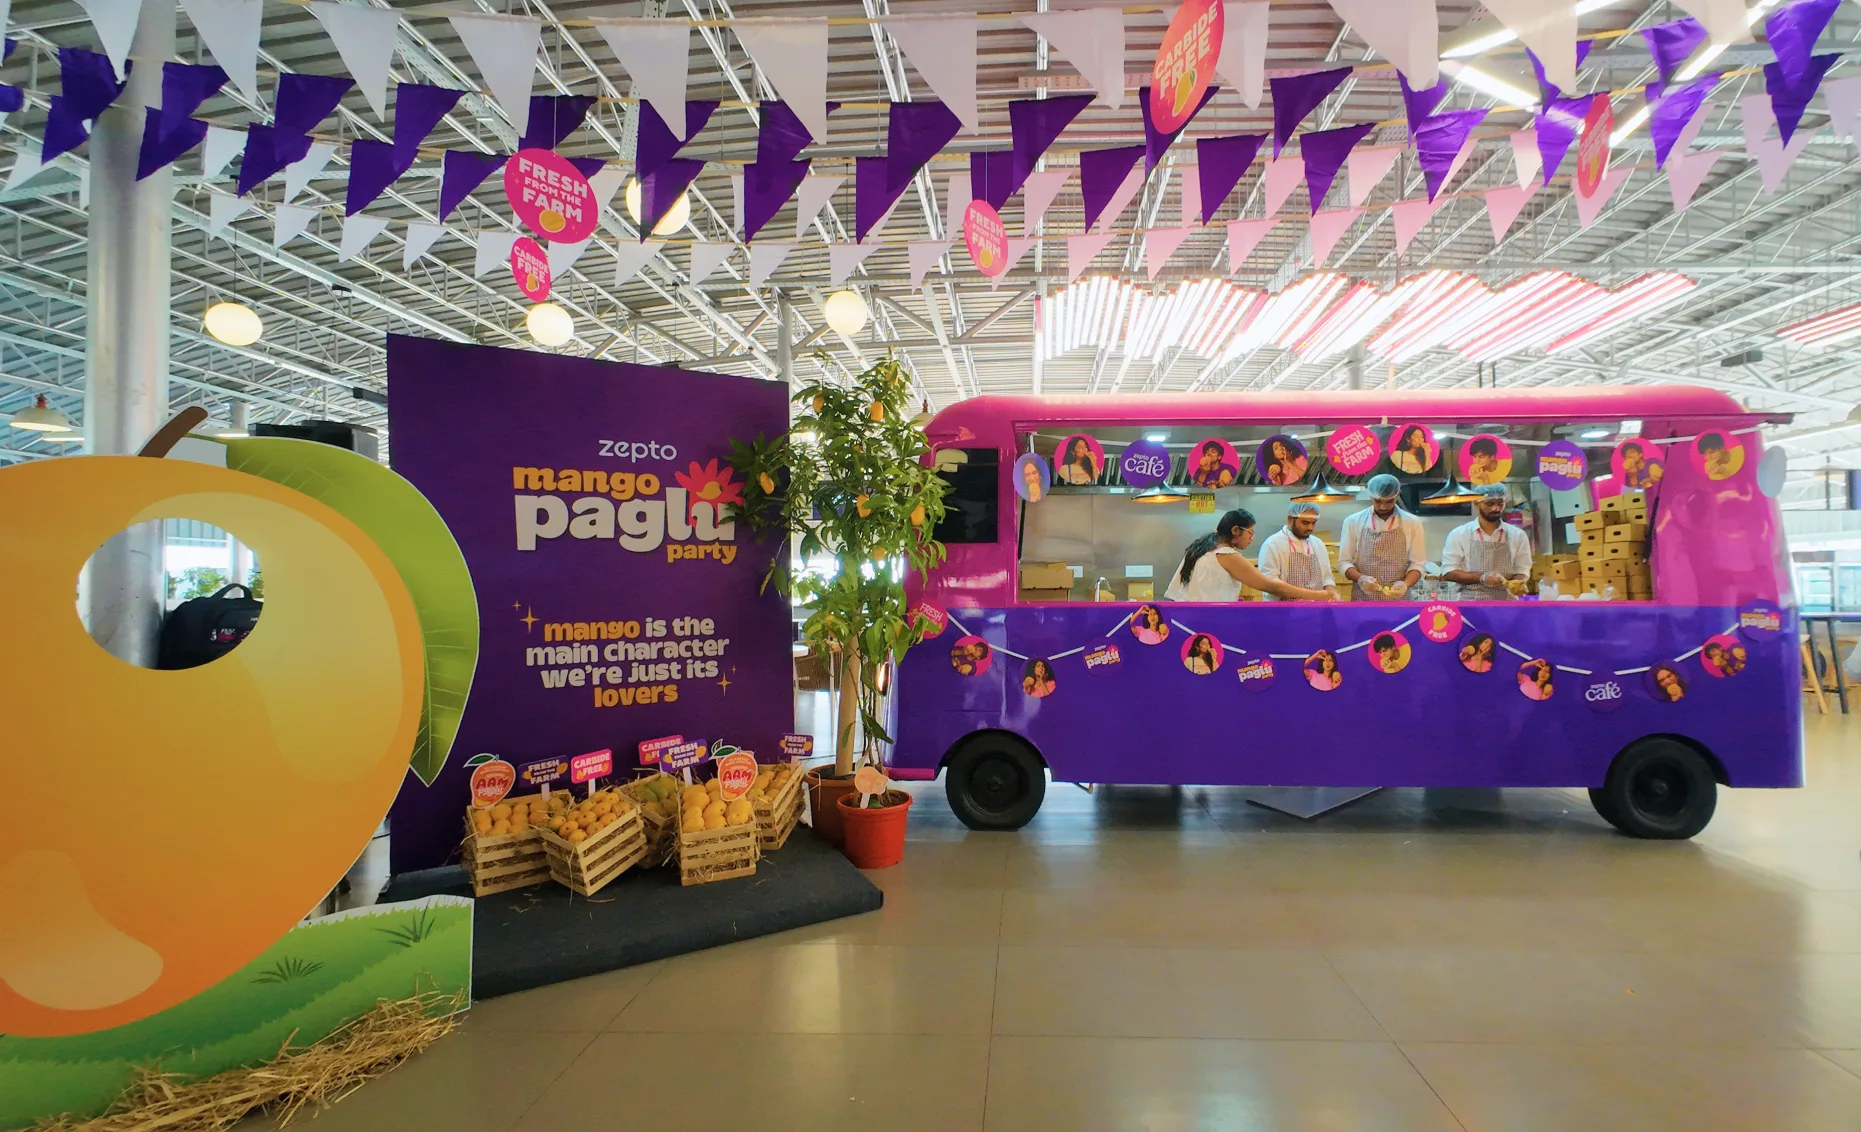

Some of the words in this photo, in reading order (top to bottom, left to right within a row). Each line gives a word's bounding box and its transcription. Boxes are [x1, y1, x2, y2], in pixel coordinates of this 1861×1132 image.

[1155, 0, 1218, 80] CARBIDE
[1160, 27, 1210, 100] FREE
[519, 157, 588, 199] FRESH
[524, 177, 558, 197] FROM
[560, 192, 582, 206] THE
[522, 187, 582, 223] FARM
[970, 208, 1003, 238] FRESH
[972, 232, 1001, 259] FARM
[513, 245, 549, 273] CARBIDE
[517, 257, 546, 284] FREE
[598, 439, 678, 463] zepto
[1332, 430, 1364, 454] FRESH
[1124, 456, 1164, 477] café
[1343, 446, 1374, 469] FARM
[1539, 461, 1582, 475] paglu
[512, 466, 660, 500] mango
[514, 487, 735, 553] paglu
[666, 542, 737, 564] party
[920, 602, 943, 622] FRESH
[1428, 605, 1456, 617] CARBIDE
[543, 620, 641, 642] mango
[645, 617, 667, 638] is
[672, 616, 715, 637] the
[1428, 629, 1447, 638] FREE
[525, 642, 598, 667] main
[603, 638, 730, 662] character
[1086, 650, 1119, 669] paglu
[627, 661, 682, 684] just
[686, 658, 719, 679] its
[1239, 665, 1273, 682] paglu
[594, 684, 679, 708] lovers
[1585, 681, 1622, 701] café
[641, 738, 681, 752] CARBIDE
[668, 742, 698, 755] FRESH
[784, 735, 806, 743] FRESH
[574, 752, 610, 769] CARBIDE
[784, 747, 805, 755] FARM
[528, 759, 560, 772] FRESH
[582, 764, 603, 776] FREE
[672, 756, 699, 769] FARM
[476, 777, 509, 789] AAM
[530, 773, 560, 785] FARM
[723, 769, 752, 782] AAM
